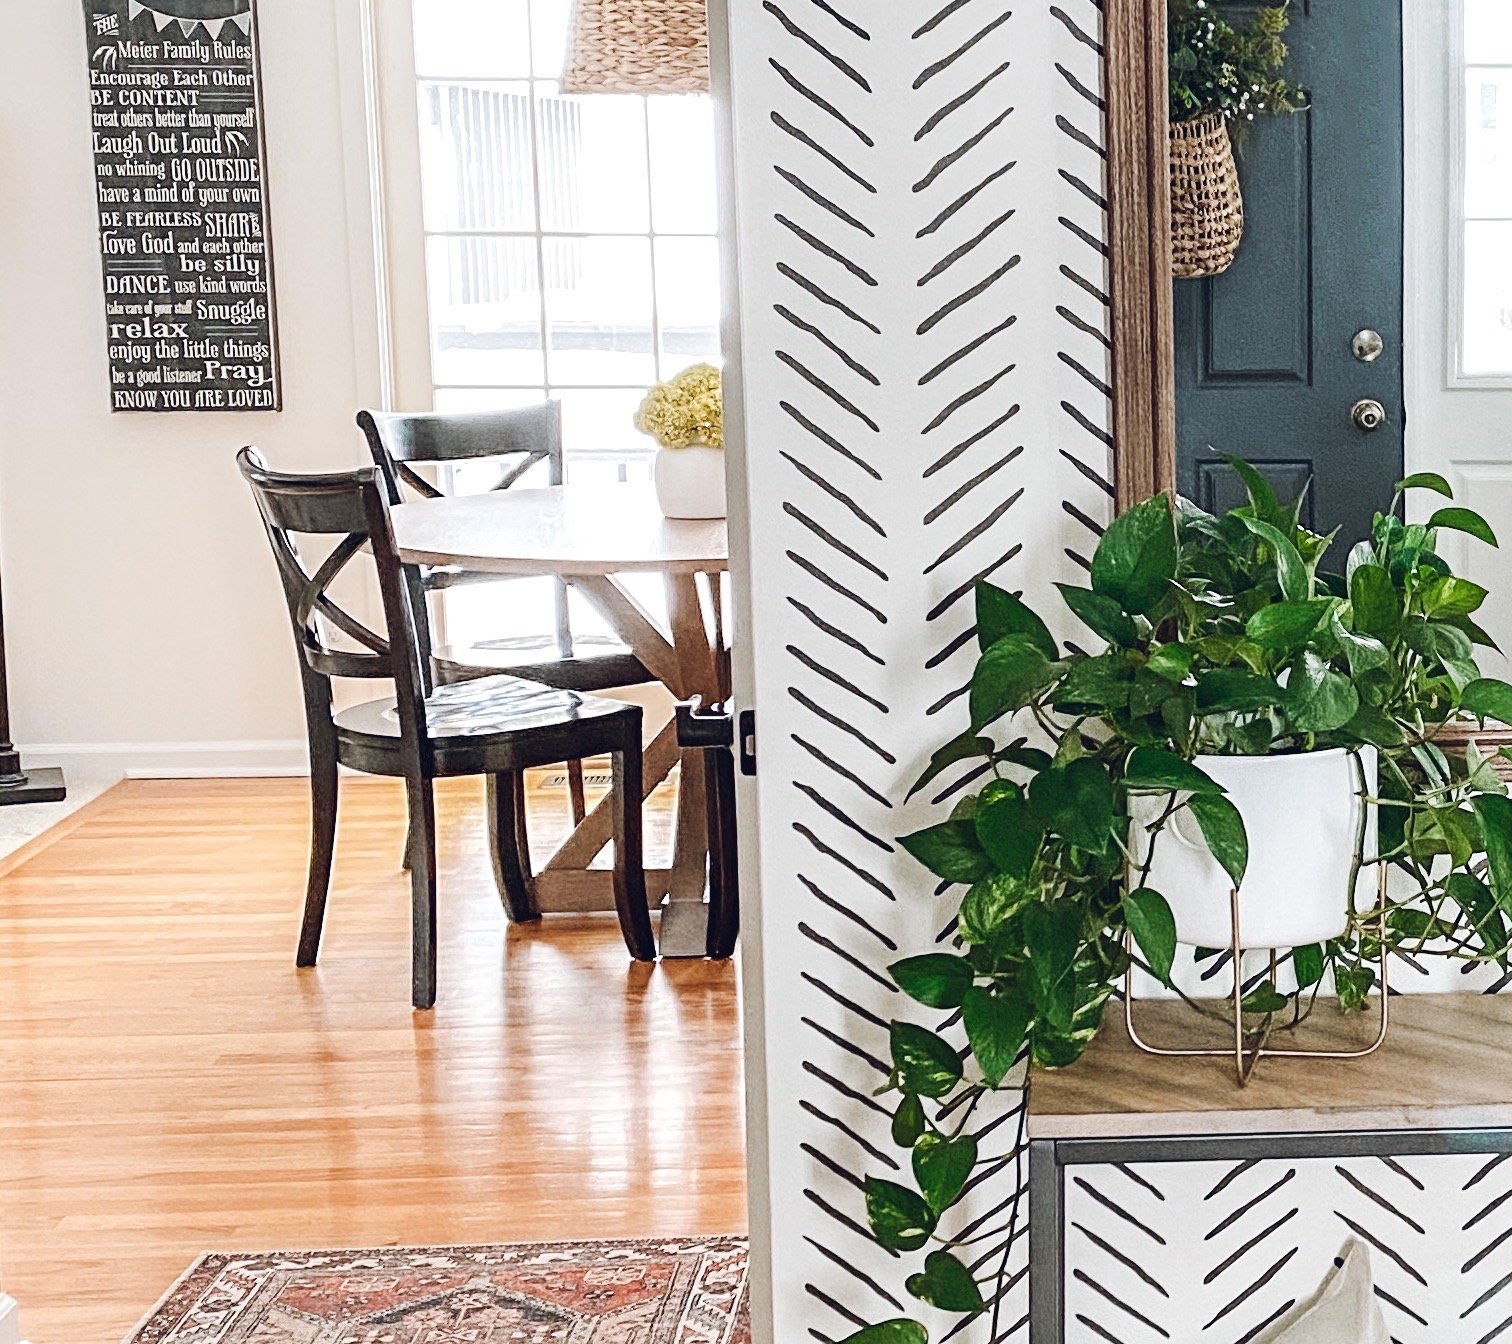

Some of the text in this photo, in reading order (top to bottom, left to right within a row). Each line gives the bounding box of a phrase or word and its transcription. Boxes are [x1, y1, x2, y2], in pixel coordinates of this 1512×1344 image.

[93, 14, 118, 34] THE
[117, 40, 251, 63] Meier Family Rules
[90, 70, 253, 88] Encourage Each Other
[91, 90, 199, 106] BE CONTENT
[93, 108, 254, 130] treat others better than yourself
[93, 128, 222, 158] Laugh Out Loud
[97, 159, 259, 181] no whining GO OUTSIDE
[99, 181, 259, 207] have a mind of your own
[101, 212, 261, 237] BE FEARLESS SHARE
[142, 231, 174, 254] God
[177, 238, 199, 254] and
[203, 238, 230, 254] each
[233, 238, 264, 254] other
[180, 254, 259, 275] be silly
[106, 275, 266, 294] DANCE use kind words
[196, 299, 265, 324] Snuggle
[110, 317, 189, 338] relax
[110, 339, 269, 363] enjoy the little things
[112, 361, 272, 387] be a good listener Pray
[114, 390, 272, 407] KNOW YOU ARE LOVED
